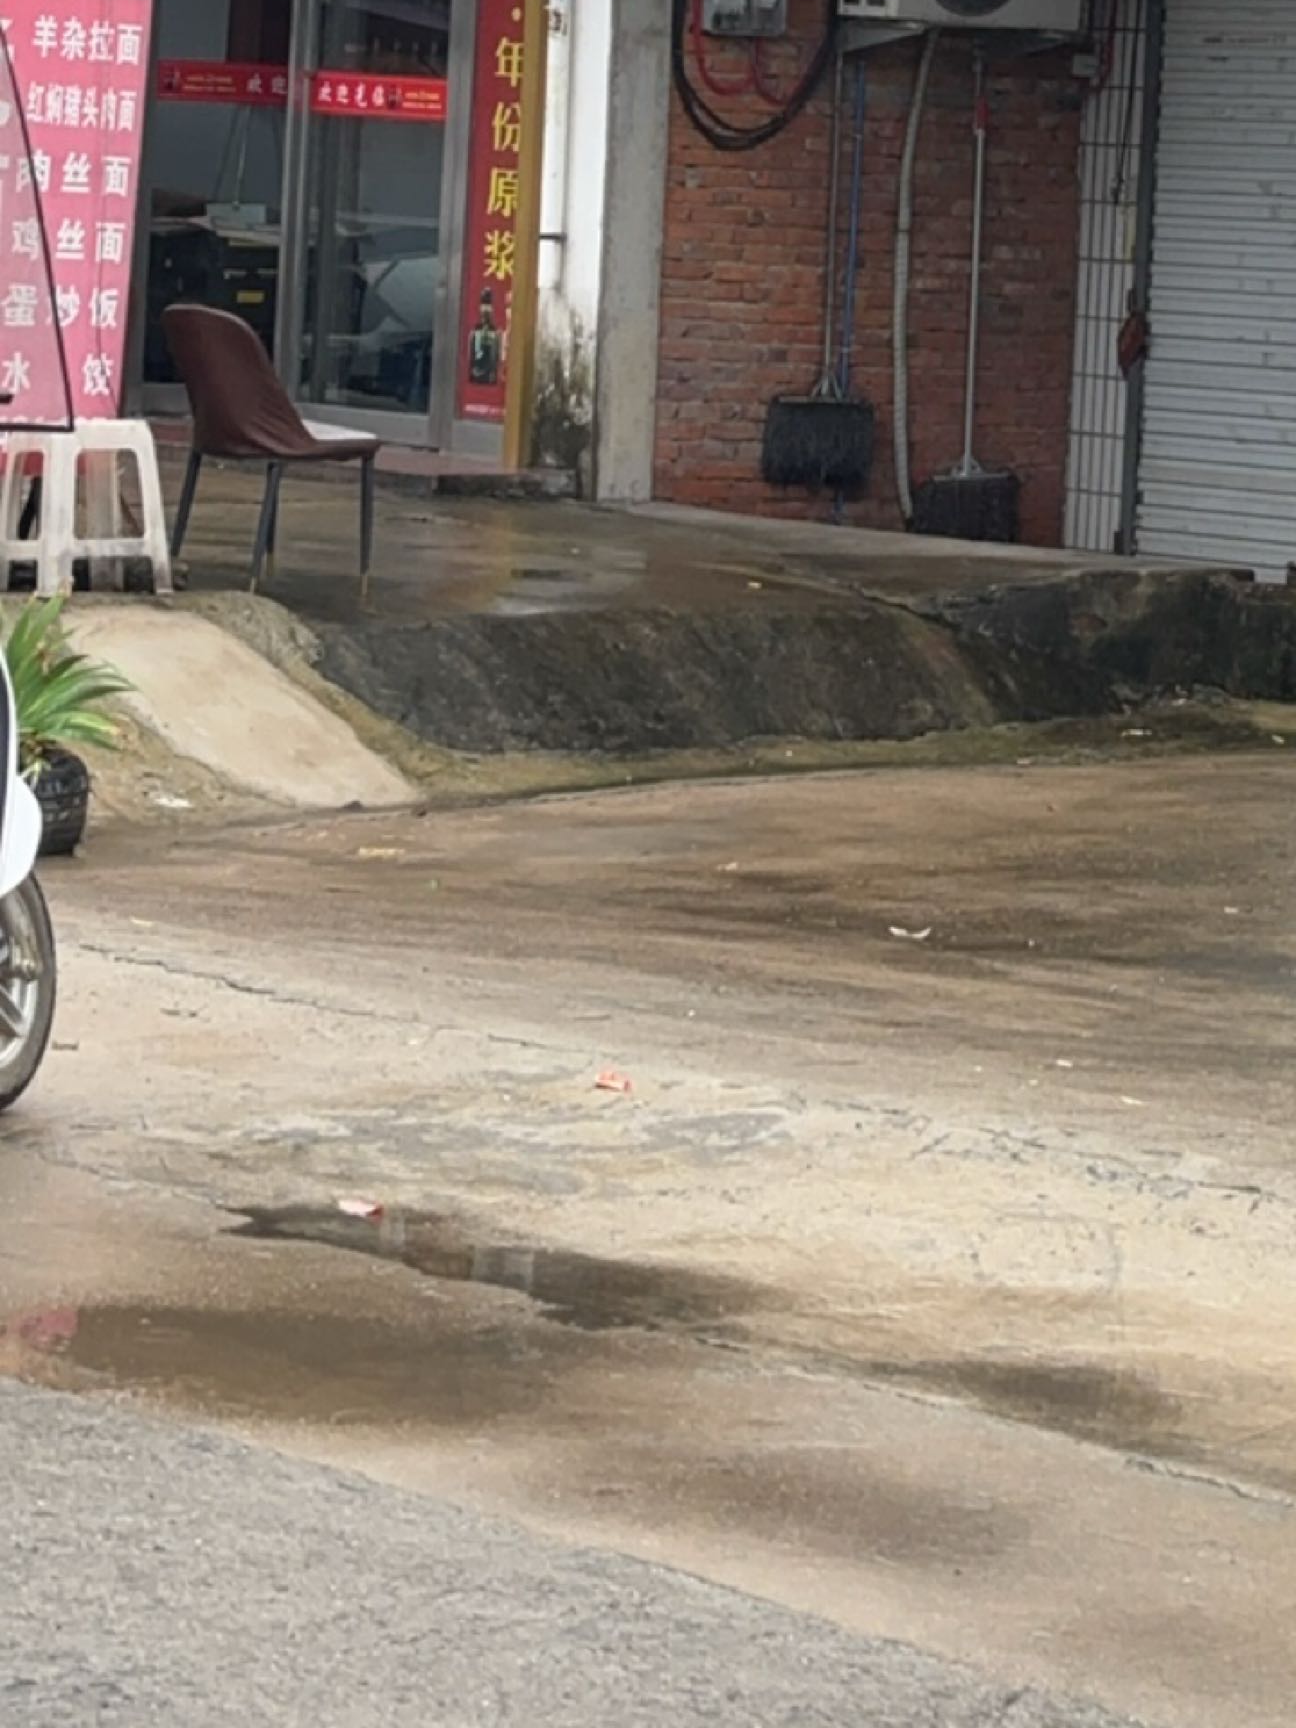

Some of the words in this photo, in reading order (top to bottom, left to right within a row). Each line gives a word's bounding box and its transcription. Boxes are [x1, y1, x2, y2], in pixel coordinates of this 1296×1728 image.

[33, 15, 143, 65] 羊杂拉面
[0, 149, 132, 197] 肉丝面
[11, 218, 126, 264] 鸡丝面
[1, 284, 119, 330] 蛋炒饭
[2, 352, 114, 396] 水饺
